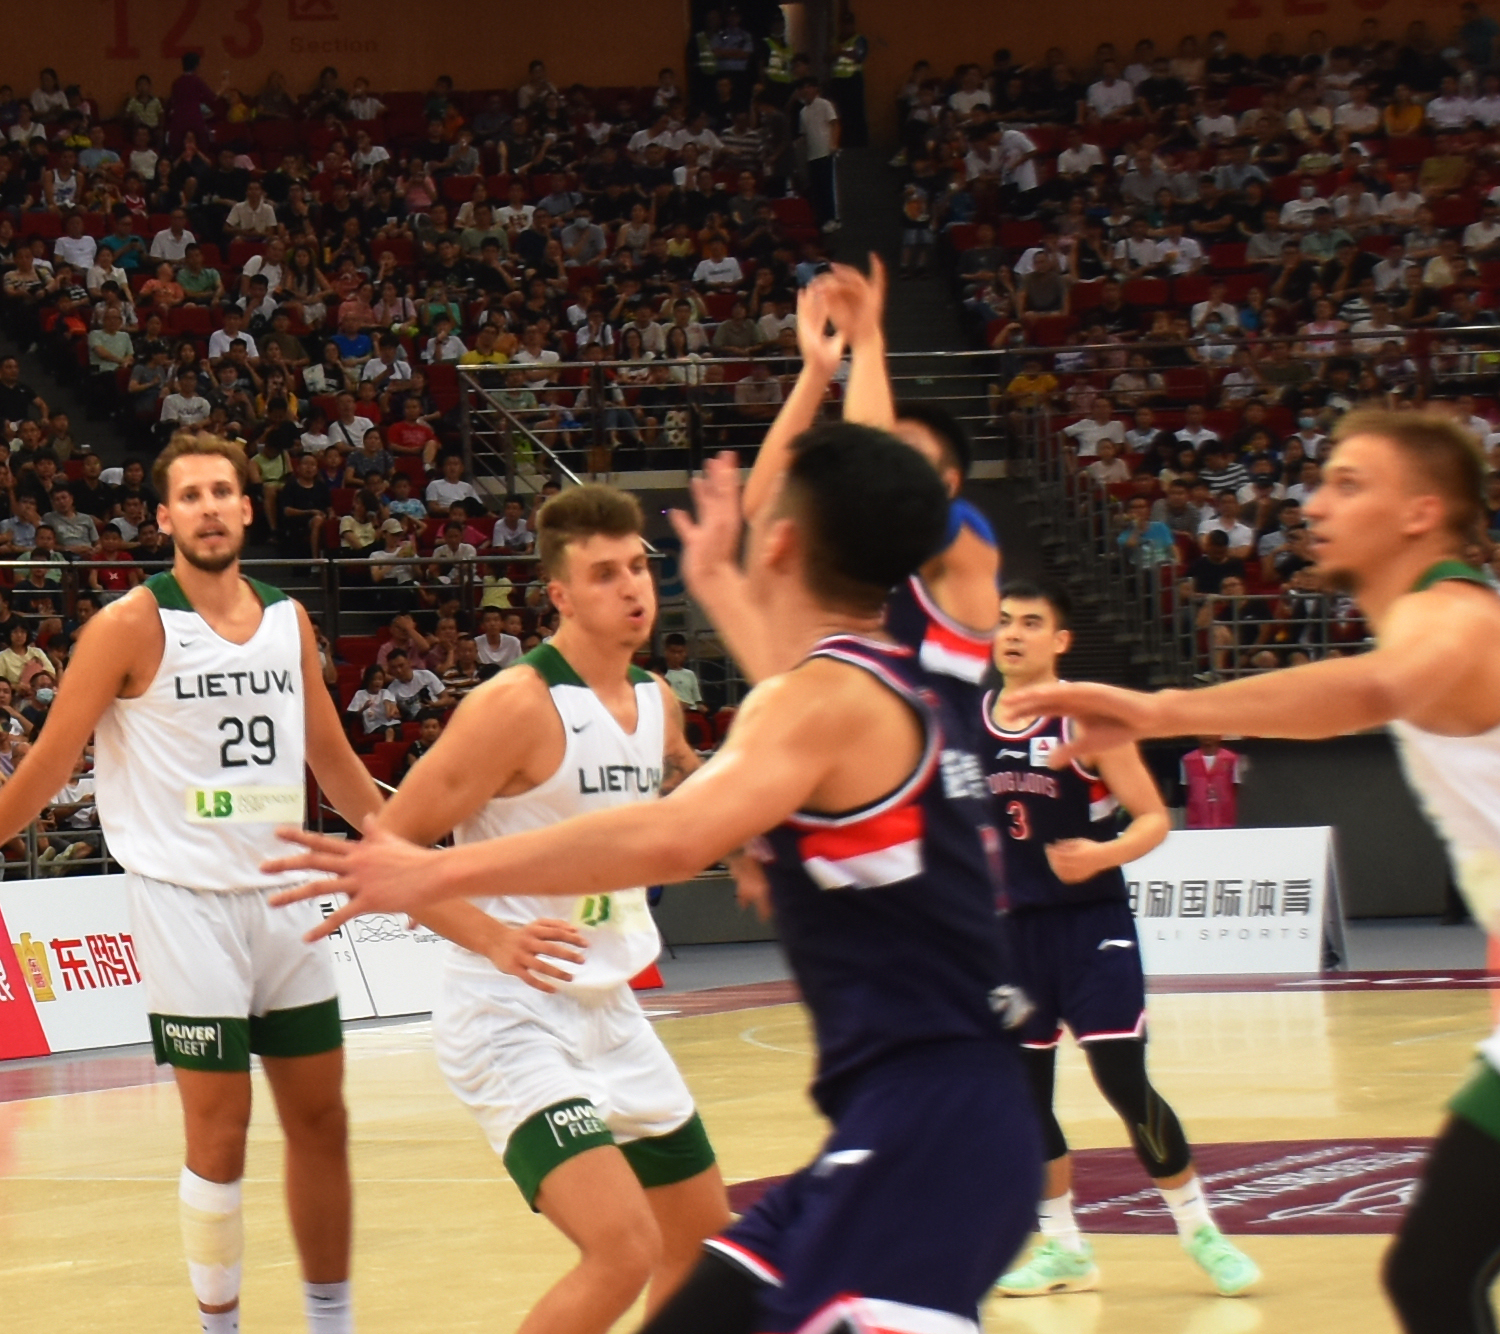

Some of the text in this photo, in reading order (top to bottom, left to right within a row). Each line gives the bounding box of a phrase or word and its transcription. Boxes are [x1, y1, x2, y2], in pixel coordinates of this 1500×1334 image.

[288, 34, 378, 55] Section
[217, 714, 277, 768] 29
[196, 790, 233, 818] LB
[1006, 799, 1031, 841] 3
[1198, 927, 1310, 942] SPORTS
[165, 1022, 216, 1042] OLIVER
[173, 1038, 208, 1057] FLEET
[553, 1105, 598, 1126] OLIV
[568, 1119, 607, 1138] FLEE
